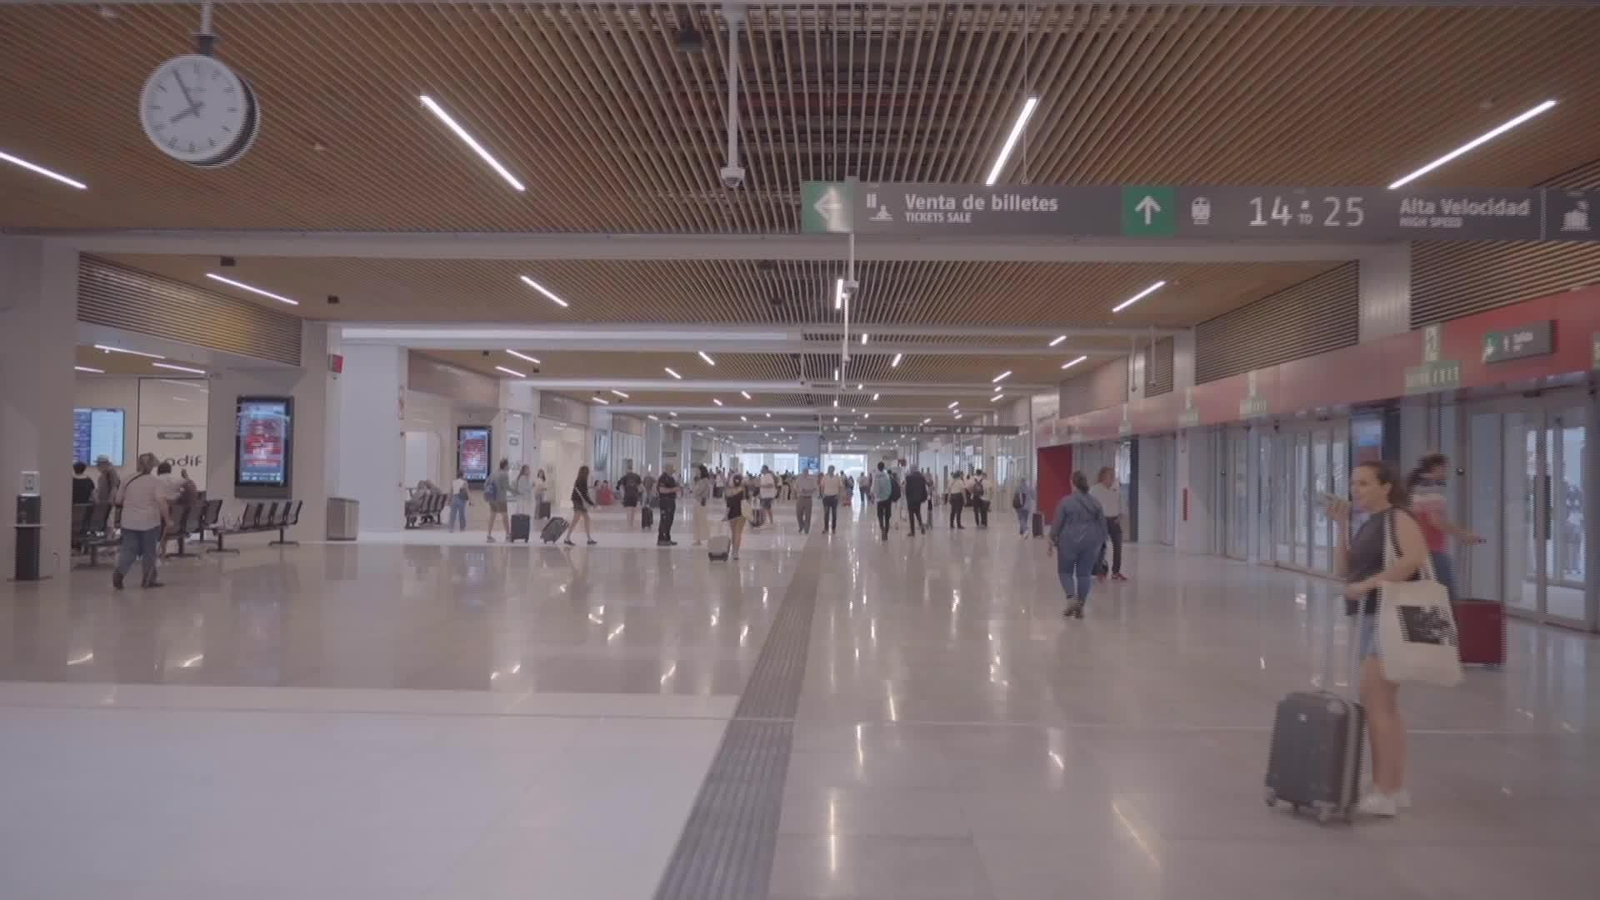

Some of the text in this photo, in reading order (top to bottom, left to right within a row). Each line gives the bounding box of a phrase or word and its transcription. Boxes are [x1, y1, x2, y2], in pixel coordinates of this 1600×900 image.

[905, 193, 1059, 212] Venta de billetes
[1249, 196, 1293, 226] 14
[1323, 196, 1365, 227] 25
[1399, 197, 1531, 216] Alta Velocidad
[905, 211, 972, 224] TICKETS SALE
